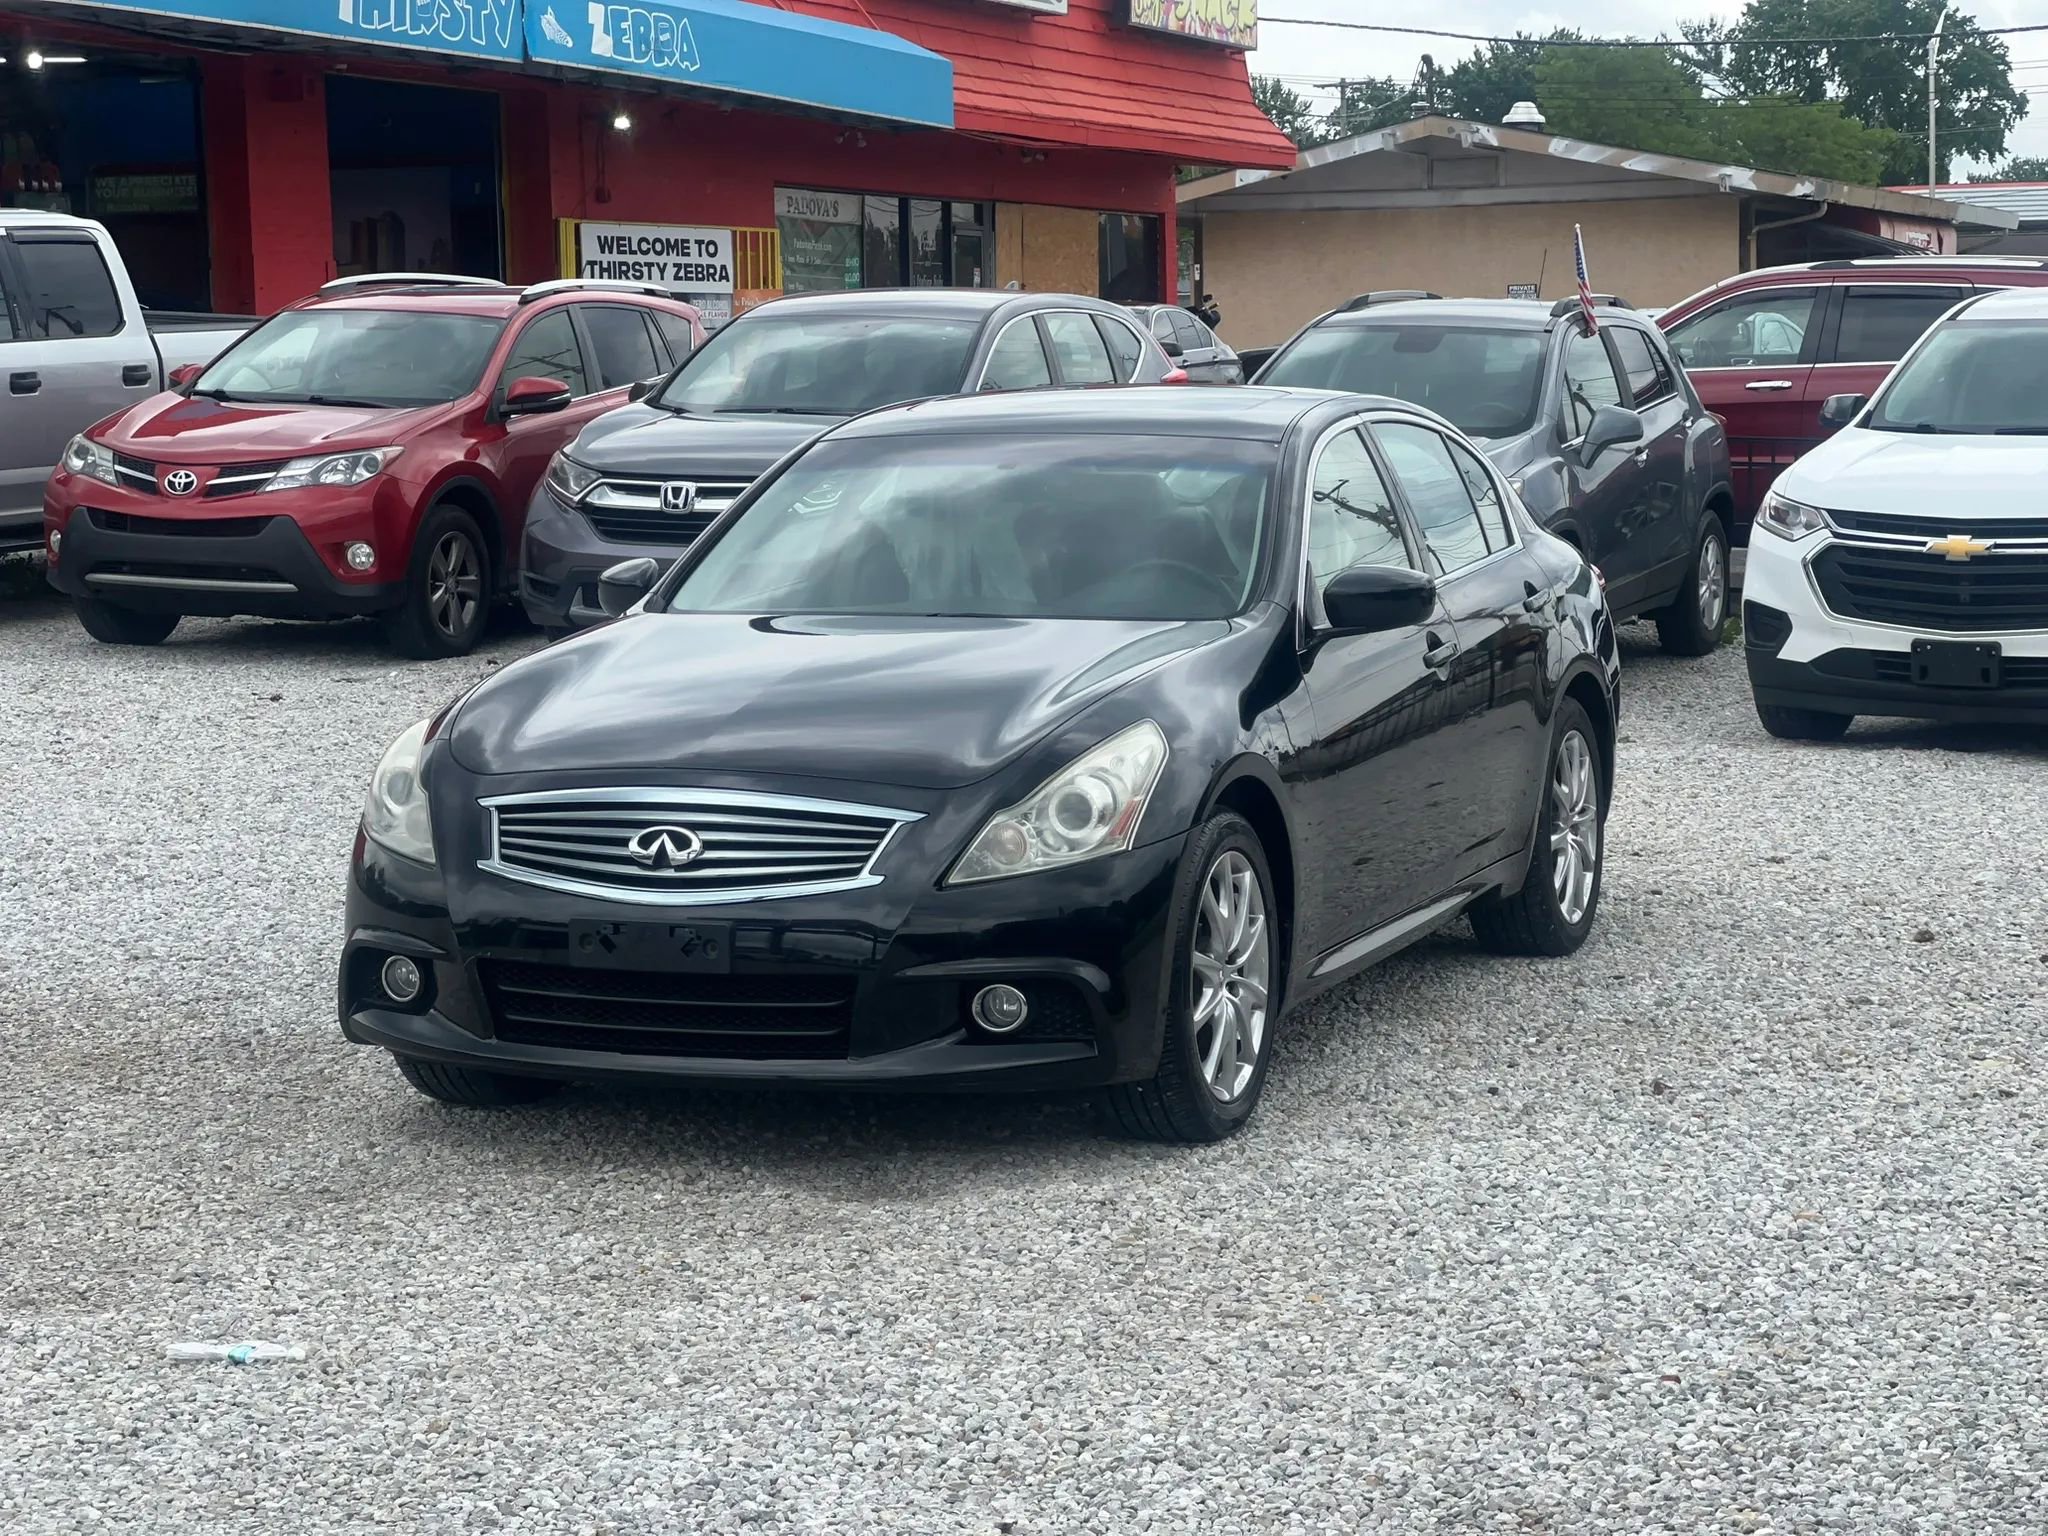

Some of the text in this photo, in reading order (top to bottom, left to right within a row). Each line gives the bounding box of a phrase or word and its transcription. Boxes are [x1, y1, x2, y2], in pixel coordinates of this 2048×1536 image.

[588, 2, 700, 71] ZEBRA
[787, 196, 840, 218] PADOVA'S
[597, 235, 719, 258] WELCOME TO
[585, 260, 730, 282] THIRSTY ZEBRA
